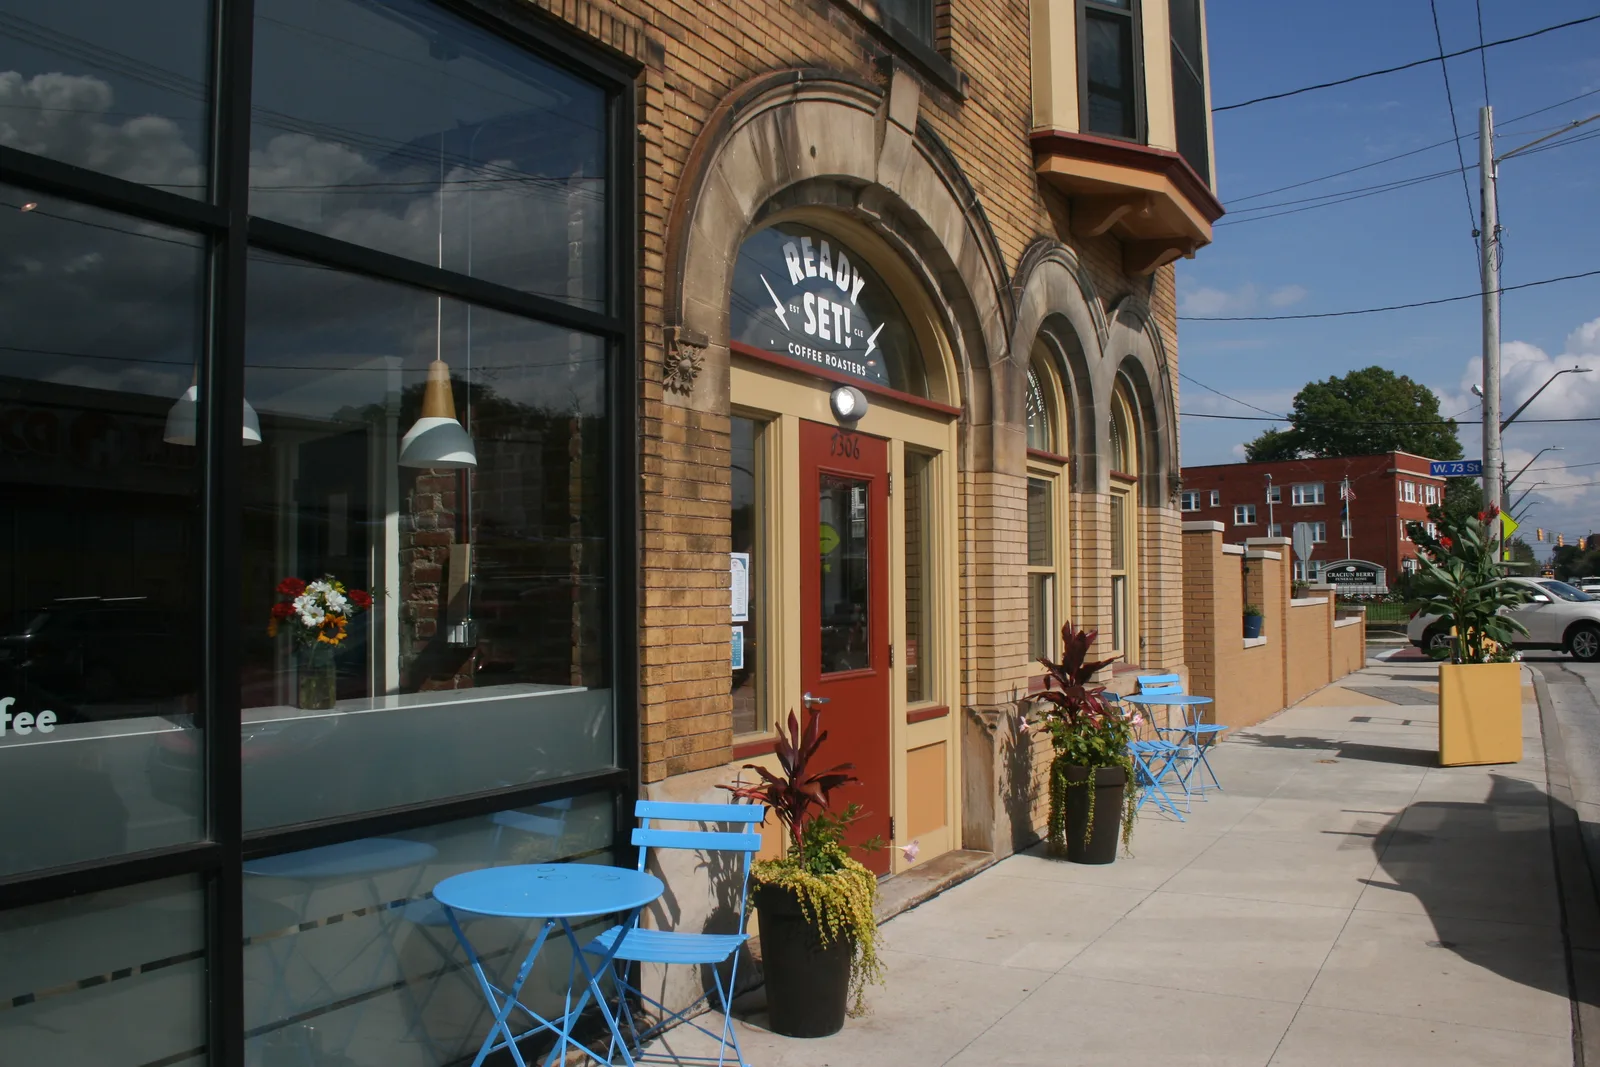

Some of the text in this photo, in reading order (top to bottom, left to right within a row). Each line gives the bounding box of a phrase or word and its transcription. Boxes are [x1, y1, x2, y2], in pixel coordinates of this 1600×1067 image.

[782, 236, 865, 306] READY
[789, 304, 800, 314] EST
[803, 291, 852, 349] SET!
[853, 328, 864, 338] CLE
[788, 342, 866, 376] COFFEE ROASTERS
[1433, 463, 1479, 473] W. 73 St
